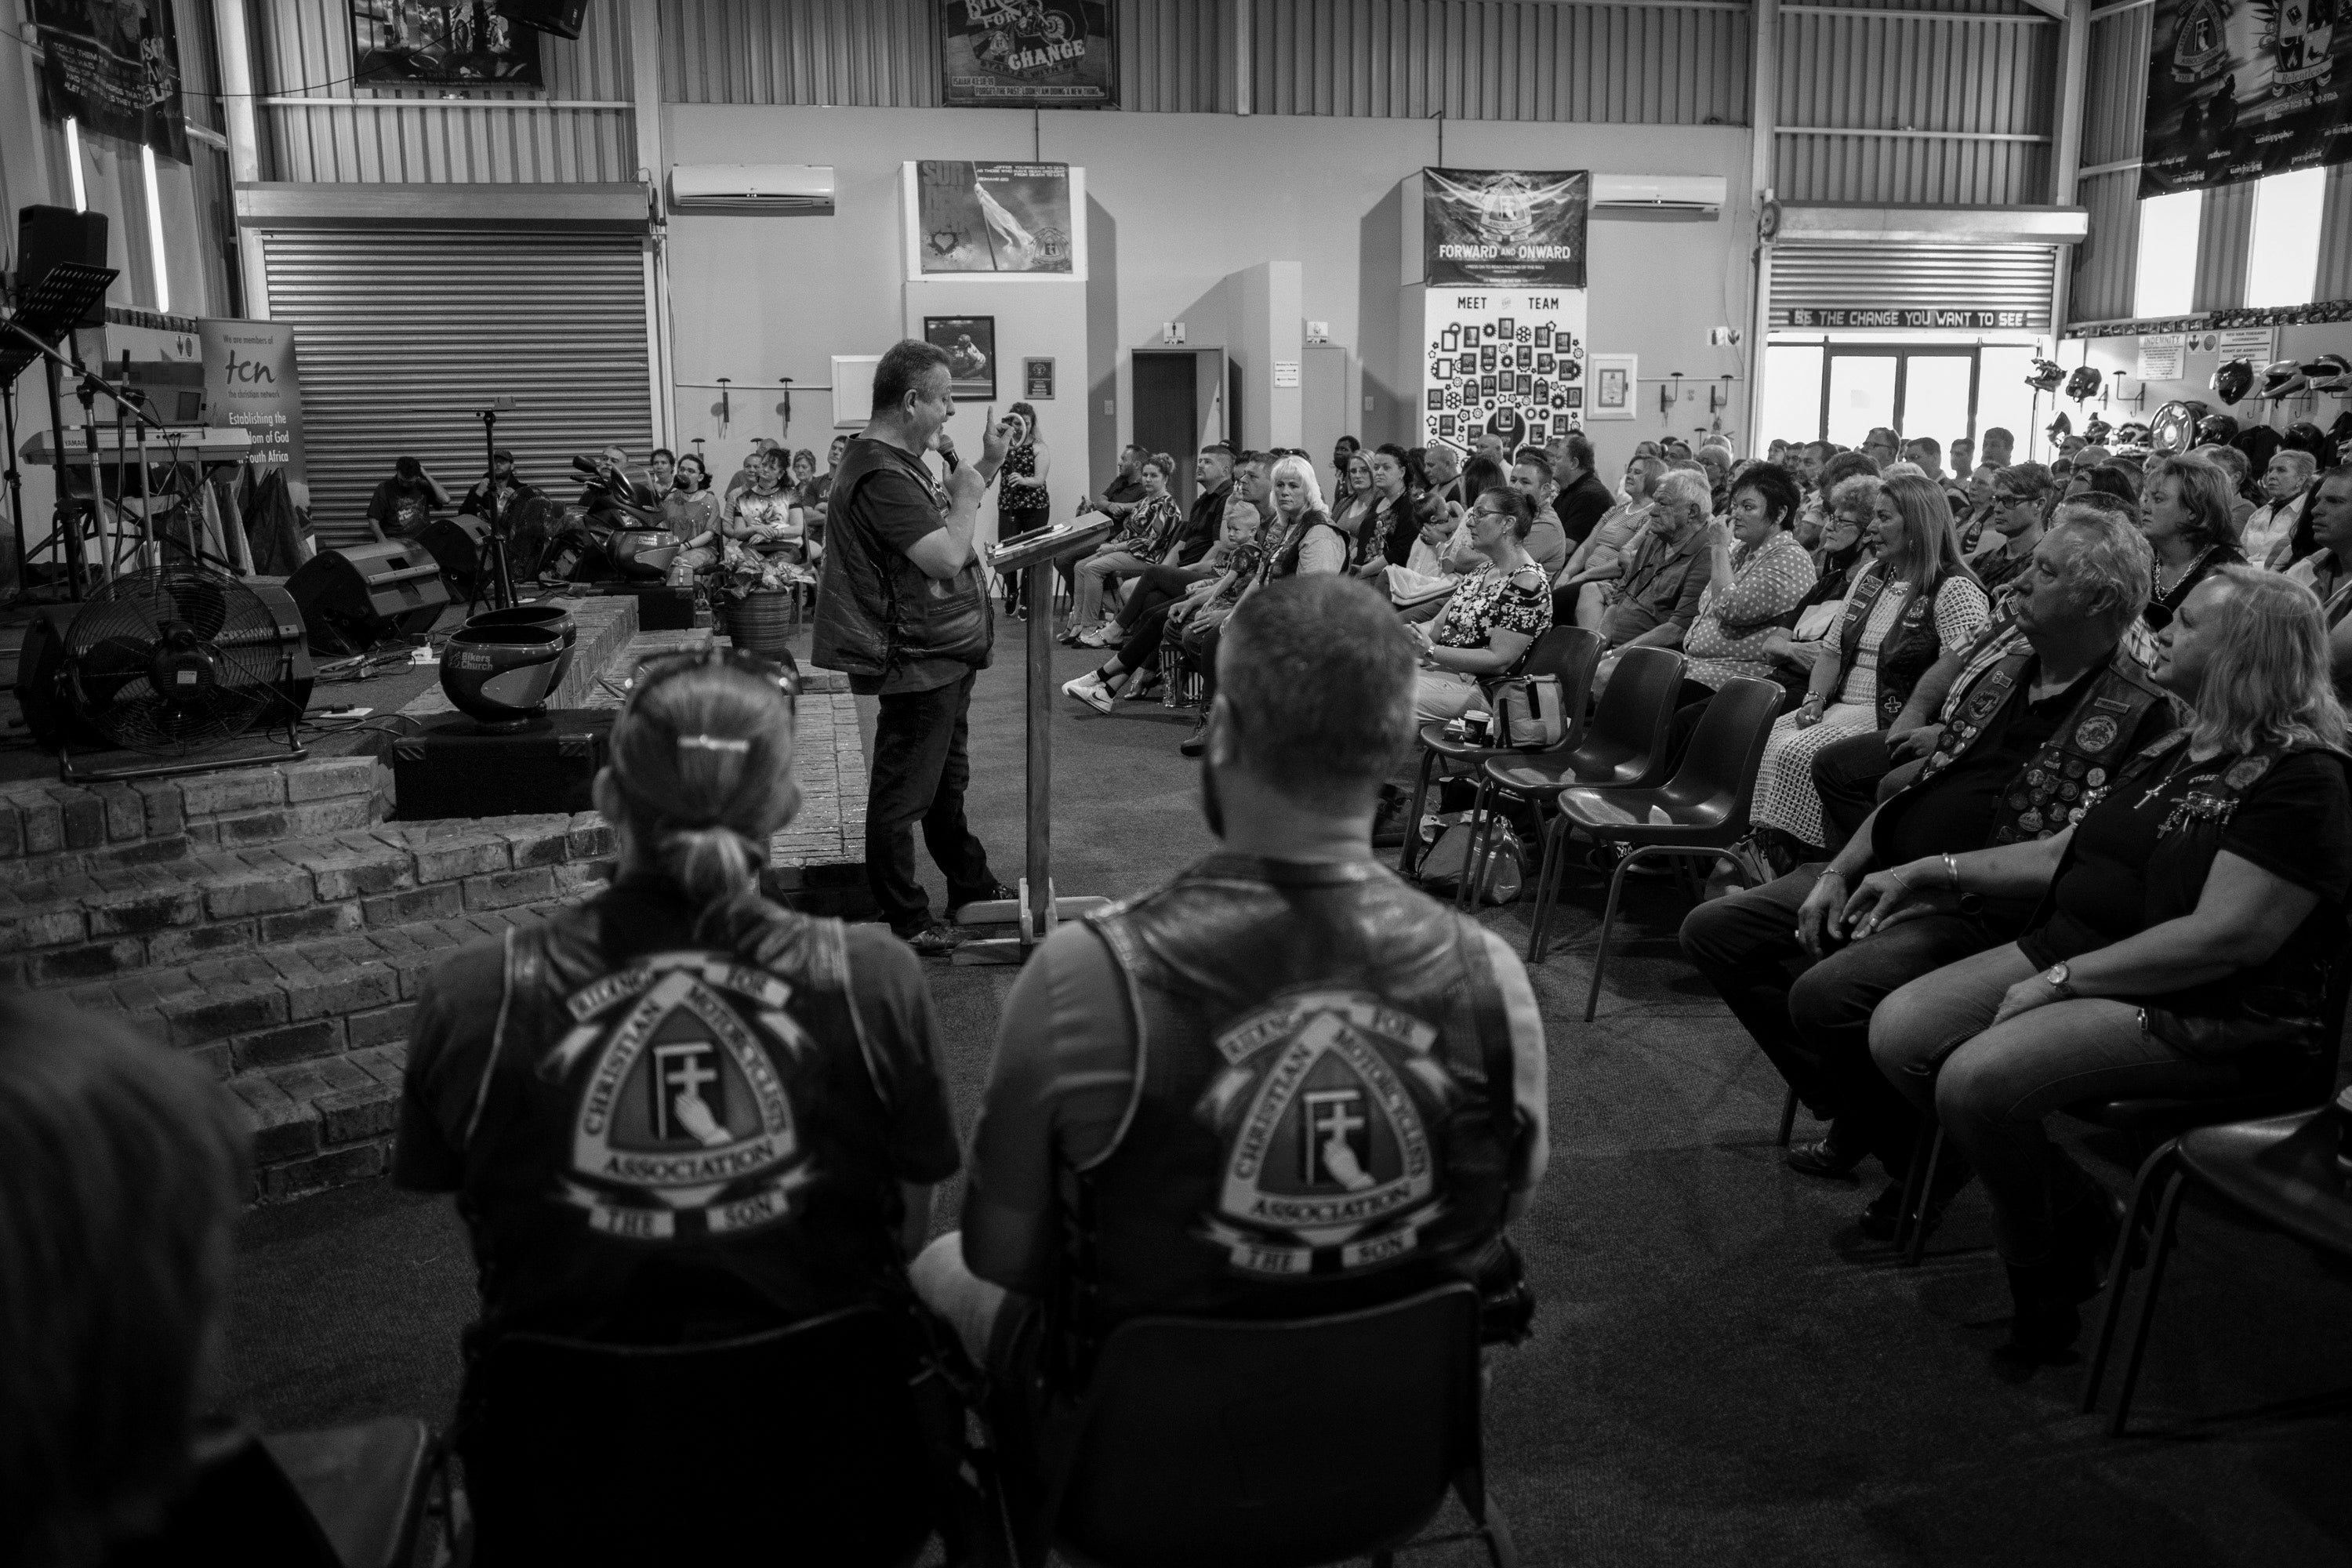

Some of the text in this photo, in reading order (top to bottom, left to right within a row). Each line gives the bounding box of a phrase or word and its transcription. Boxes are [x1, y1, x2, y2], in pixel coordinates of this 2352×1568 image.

[983, 11, 1018, 29] FOR
[1008, 38, 1085, 70] CHANGE
[2281, 67, 2324, 84] Relentless
[923, 162, 965, 185] SUR
[1439, 245, 1497, 259] FORWARD
[1519, 245, 1571, 260] ONWARD
[1457, 296, 1487, 310] MEET
[1528, 297, 1559, 310] TEAM
[1819, 311, 1844, 325] THE
[1849, 311, 1899, 326] CHANGE
[1905, 310, 1930, 325] YOU
[1936, 311, 1972, 326] WANT
[1977, 312, 1994, 326] TO
[1998, 312, 2023, 326] SEE
[223, 335, 232, 343] We
[244, 336, 267, 345] members
[267, 336, 274, 345] of
[2144, 336, 2181, 345] INDEMNITY
[225, 350, 277, 384] tcn
[228, 390, 281, 399] the christian network
[229, 412, 286, 427] Establishing the
[266, 430, 274, 444] of
[274, 430, 290, 444] God
[268, 450, 289, 463] Africa
[461, 660, 493, 671] Church
[462, 652, 491, 662] Bikers
[575, 969, 767, 1014] RIDING FOR
[1228, 1008, 1411, 1054] RIDING FOR
[583, 1003, 662, 1136] CHRISTIAN
[1233, 1043, 1311, 1180] CHRISTIAN
[605, 1144, 775, 1180] ASSOCIATION
[1251, 1182, 1411, 1219] ASSOCIATION
[611, 1199, 774, 1236] THE SON
[1248, 1236, 1403, 1271] THE SON
